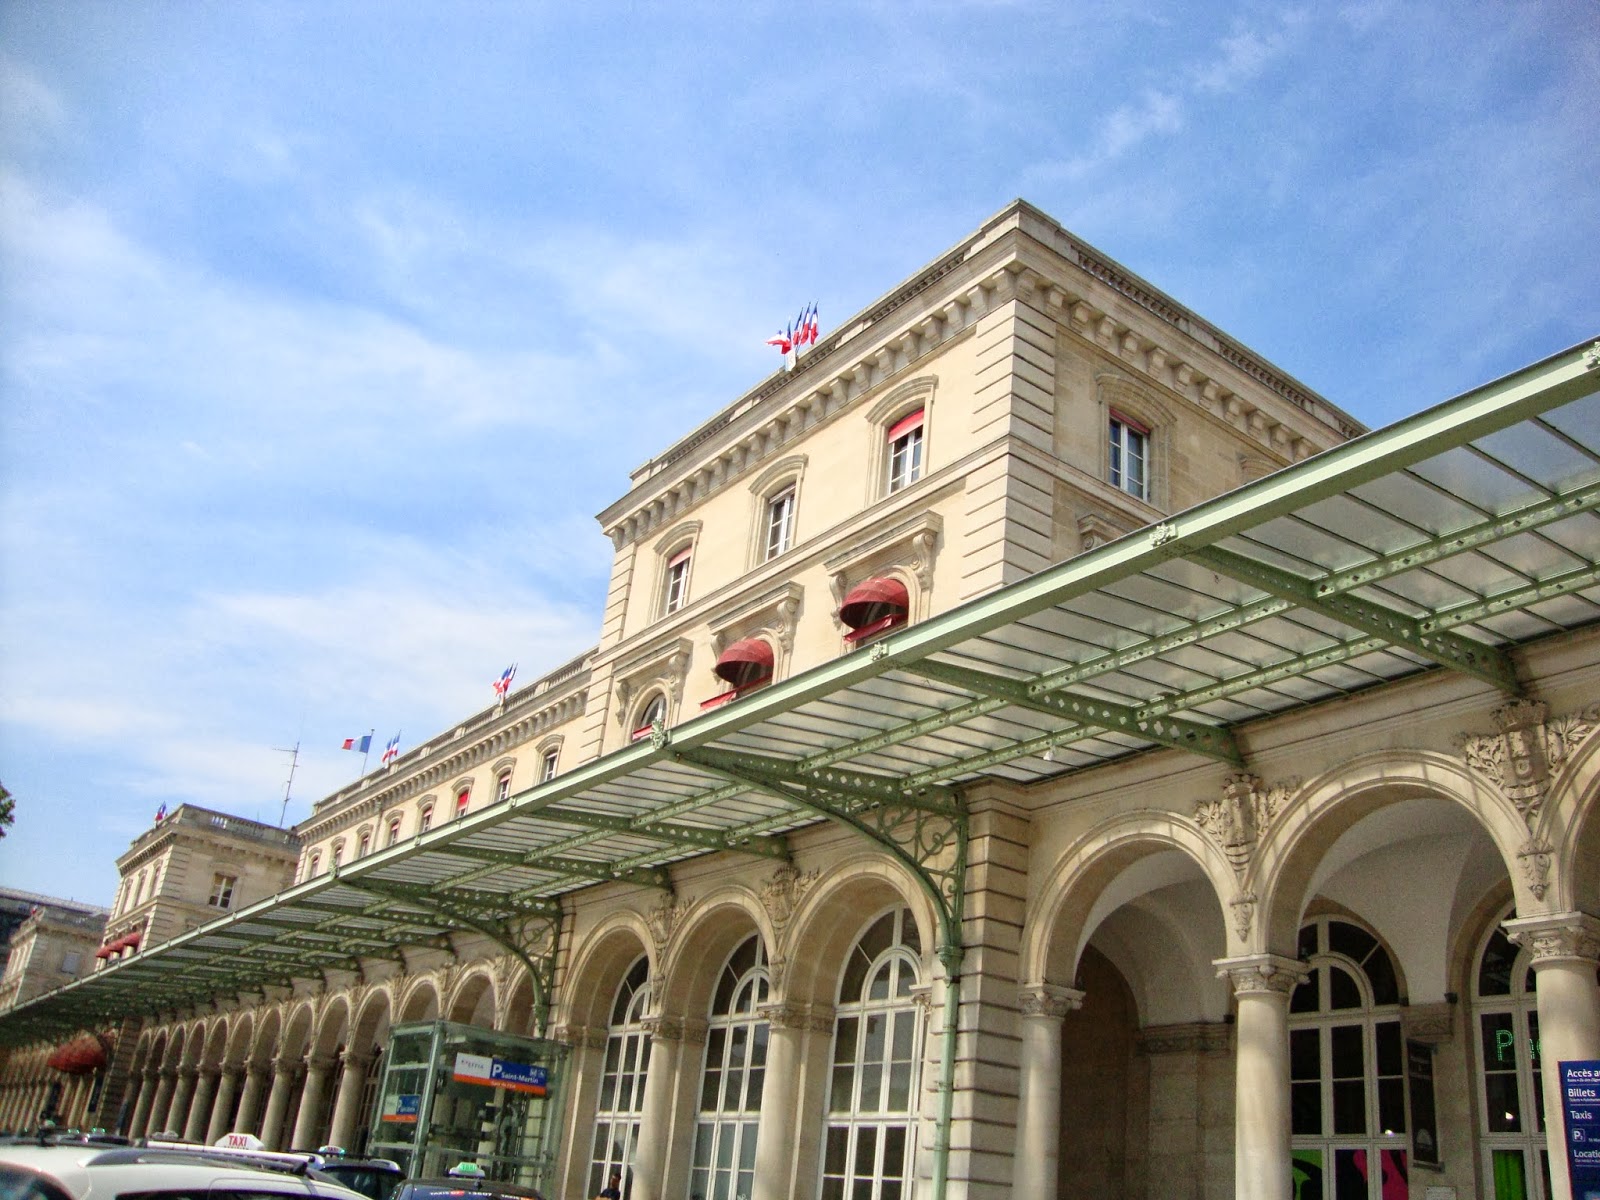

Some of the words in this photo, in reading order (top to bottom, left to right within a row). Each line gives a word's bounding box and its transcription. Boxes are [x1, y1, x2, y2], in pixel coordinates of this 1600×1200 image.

[492, 1063, 503, 1077] P
[1567, 1068, 1593, 1078] Accès
[501, 1072, 539, 1084] Saint-Martin
[1568, 1088, 1596, 1097] Billets
[1570, 1110, 1592, 1120] Taxis
[228, 1135, 248, 1147] TAXI
